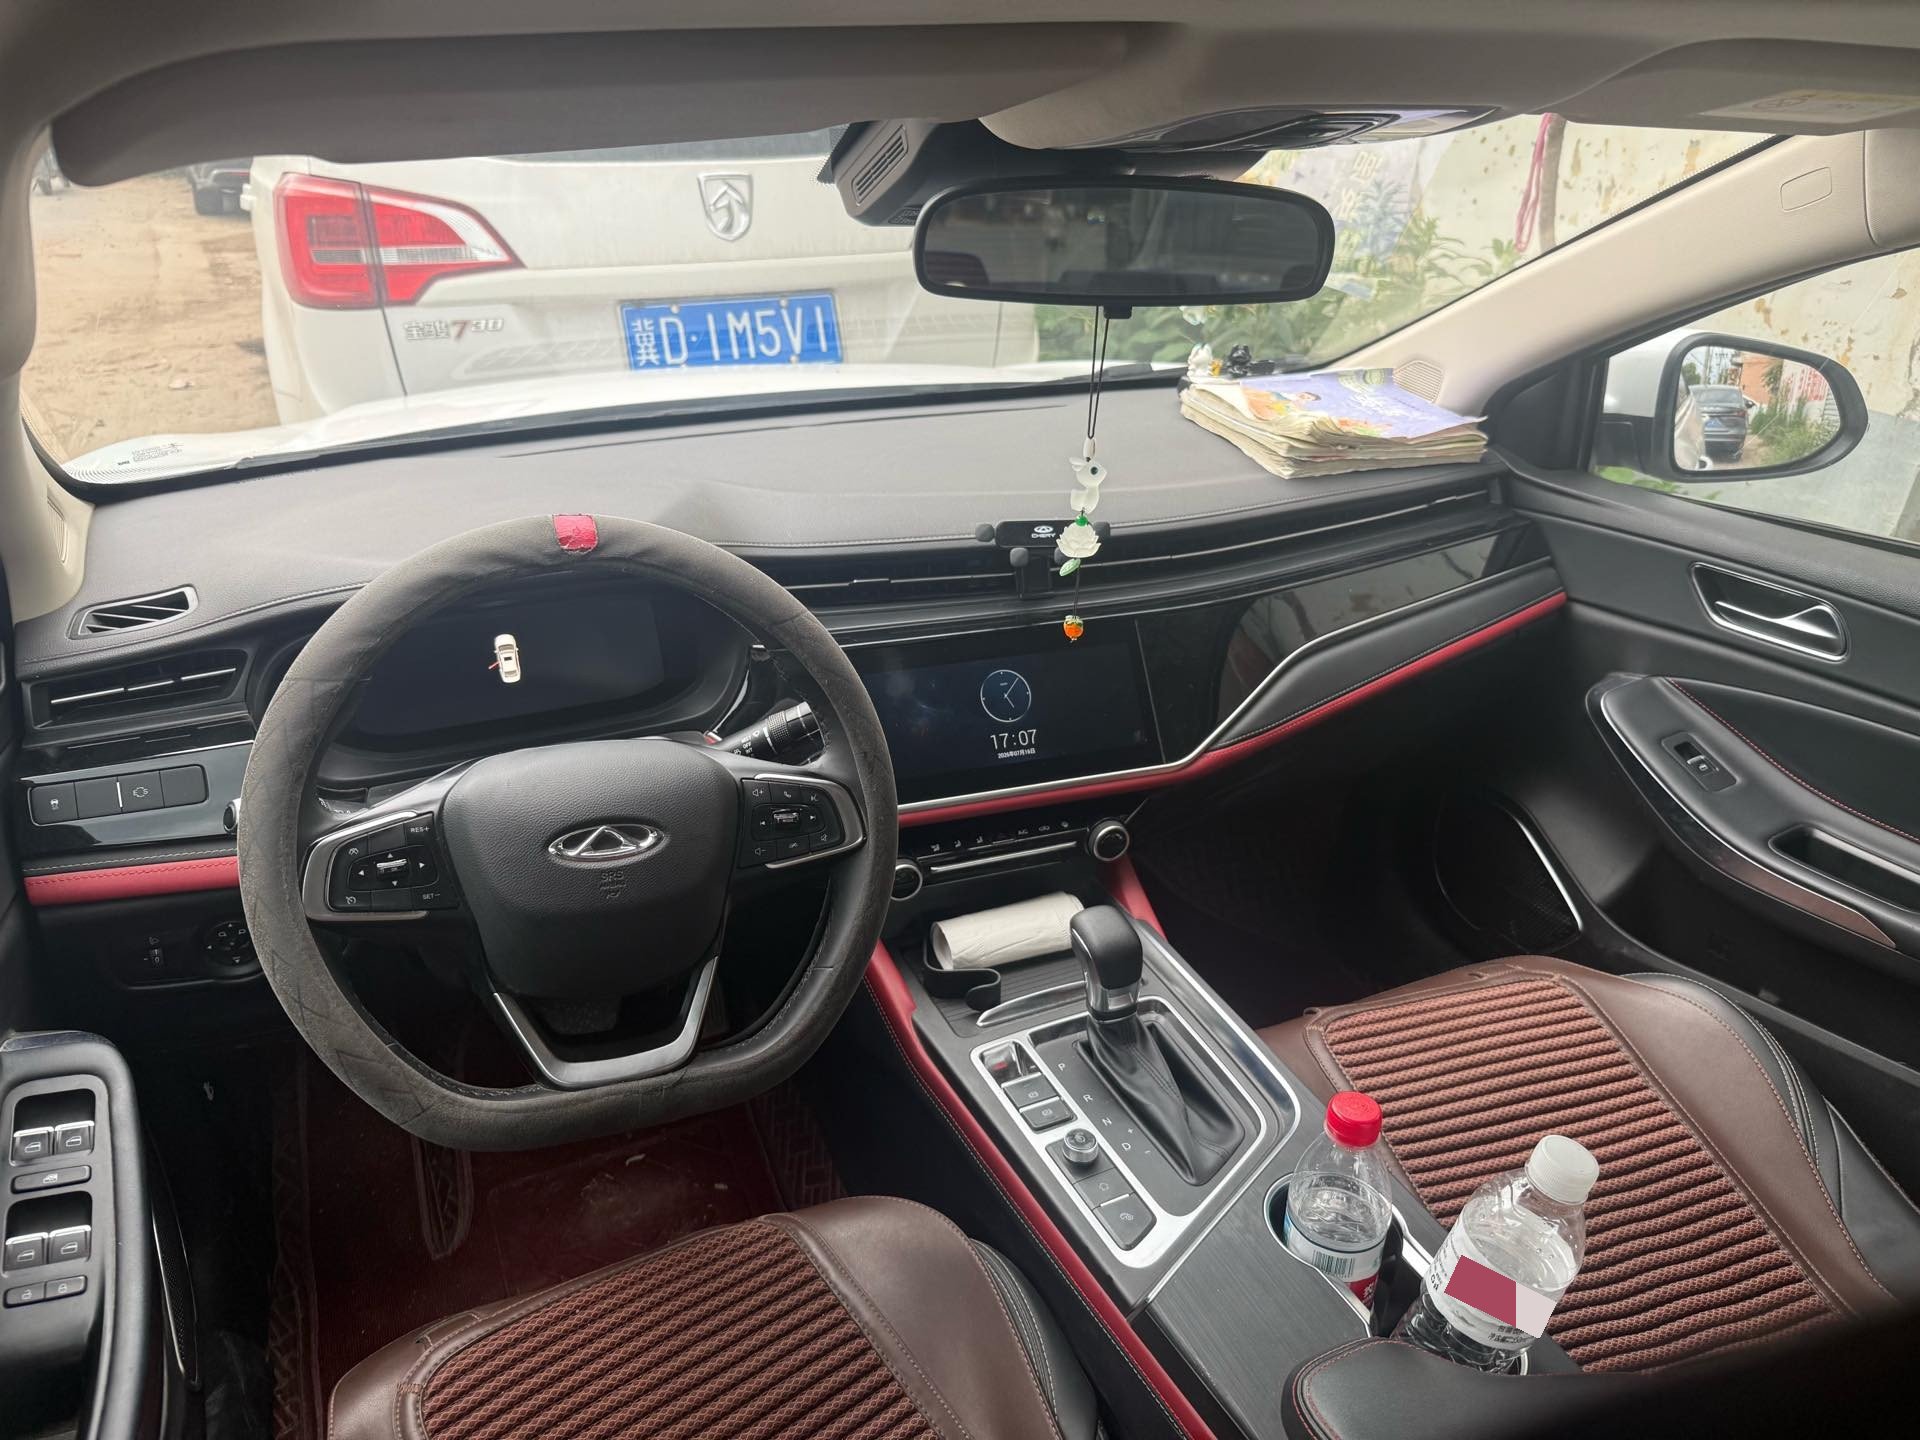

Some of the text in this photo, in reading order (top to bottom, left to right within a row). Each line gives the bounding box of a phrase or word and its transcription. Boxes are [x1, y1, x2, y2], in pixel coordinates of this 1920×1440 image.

[990, 729, 1037, 750] 17:07
[1058, 1063, 1066, 1071] P
[1083, 1094, 1093, 1102] R
[1102, 1117, 1112, 1126] N
[1121, 1142, 1131, 1151] D
